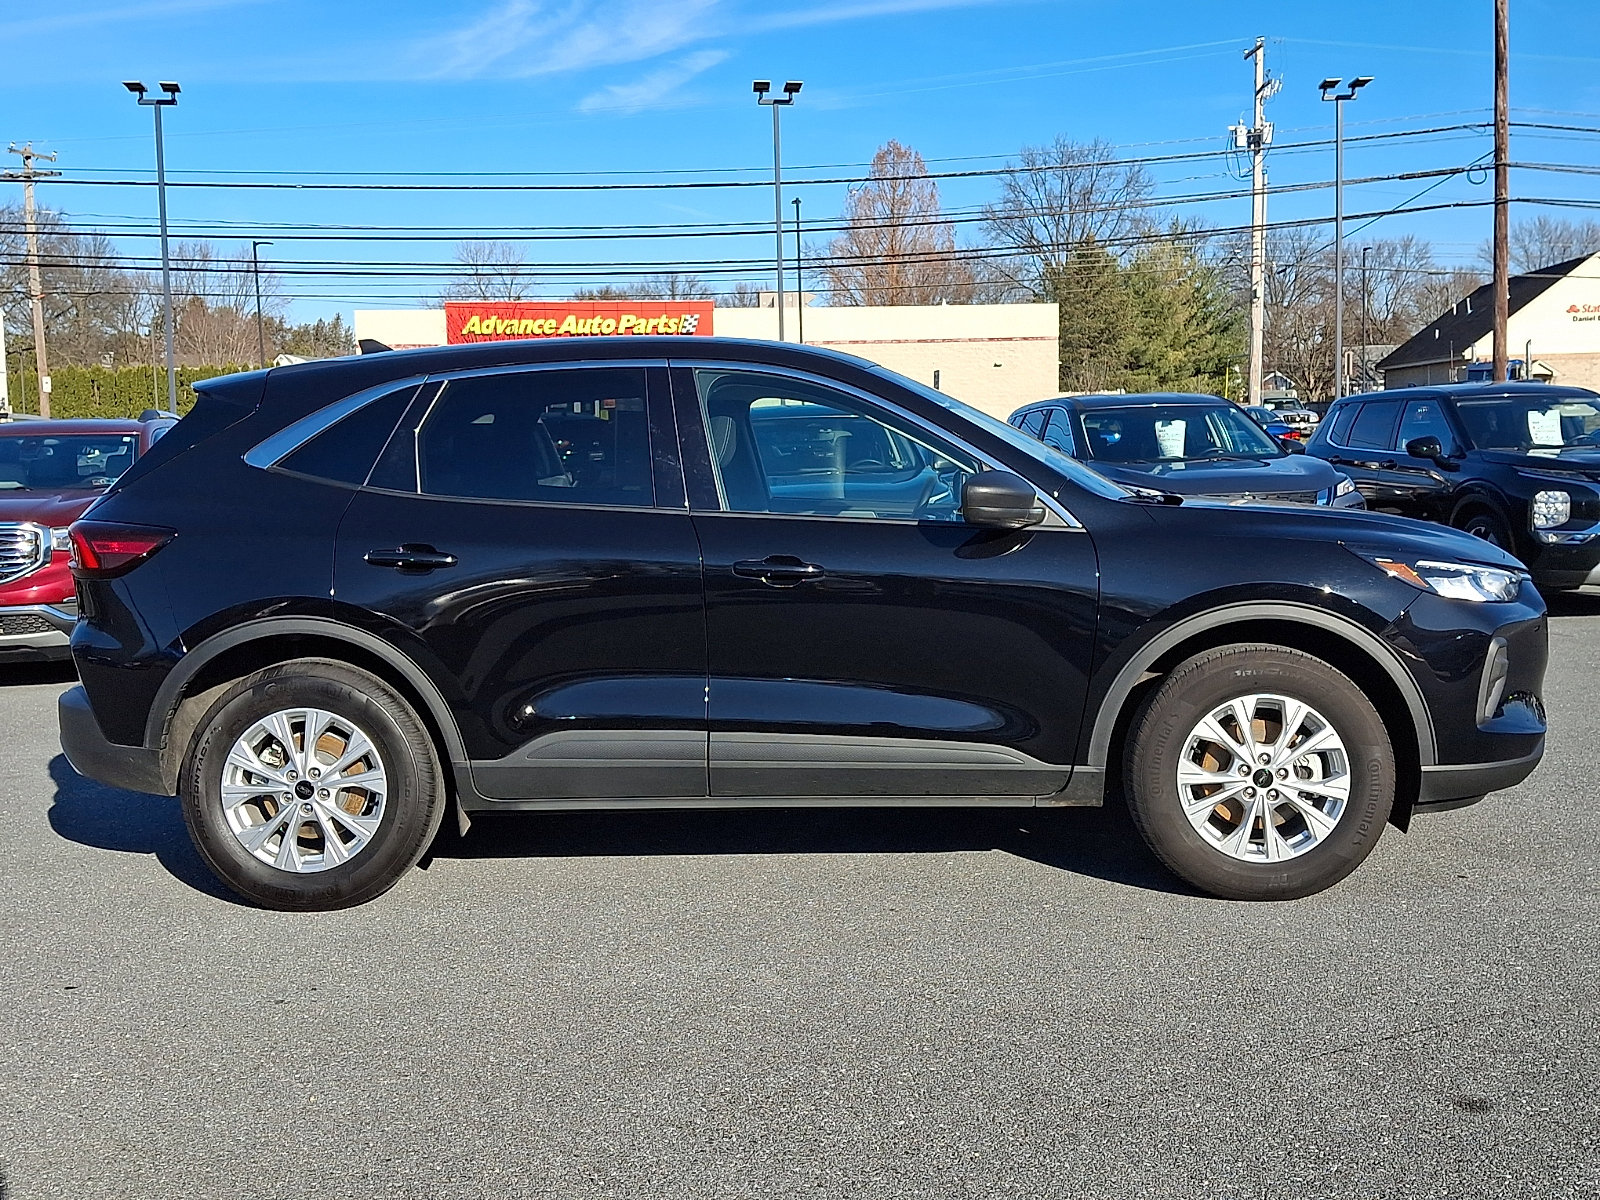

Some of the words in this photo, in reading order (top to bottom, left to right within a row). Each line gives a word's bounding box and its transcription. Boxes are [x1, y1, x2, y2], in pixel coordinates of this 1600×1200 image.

[462, 314, 556, 335] Advance
[557, 314, 618, 335] Auto
[617, 314, 680, 334] Parts
[1356, 757, 1383, 839] Continental
